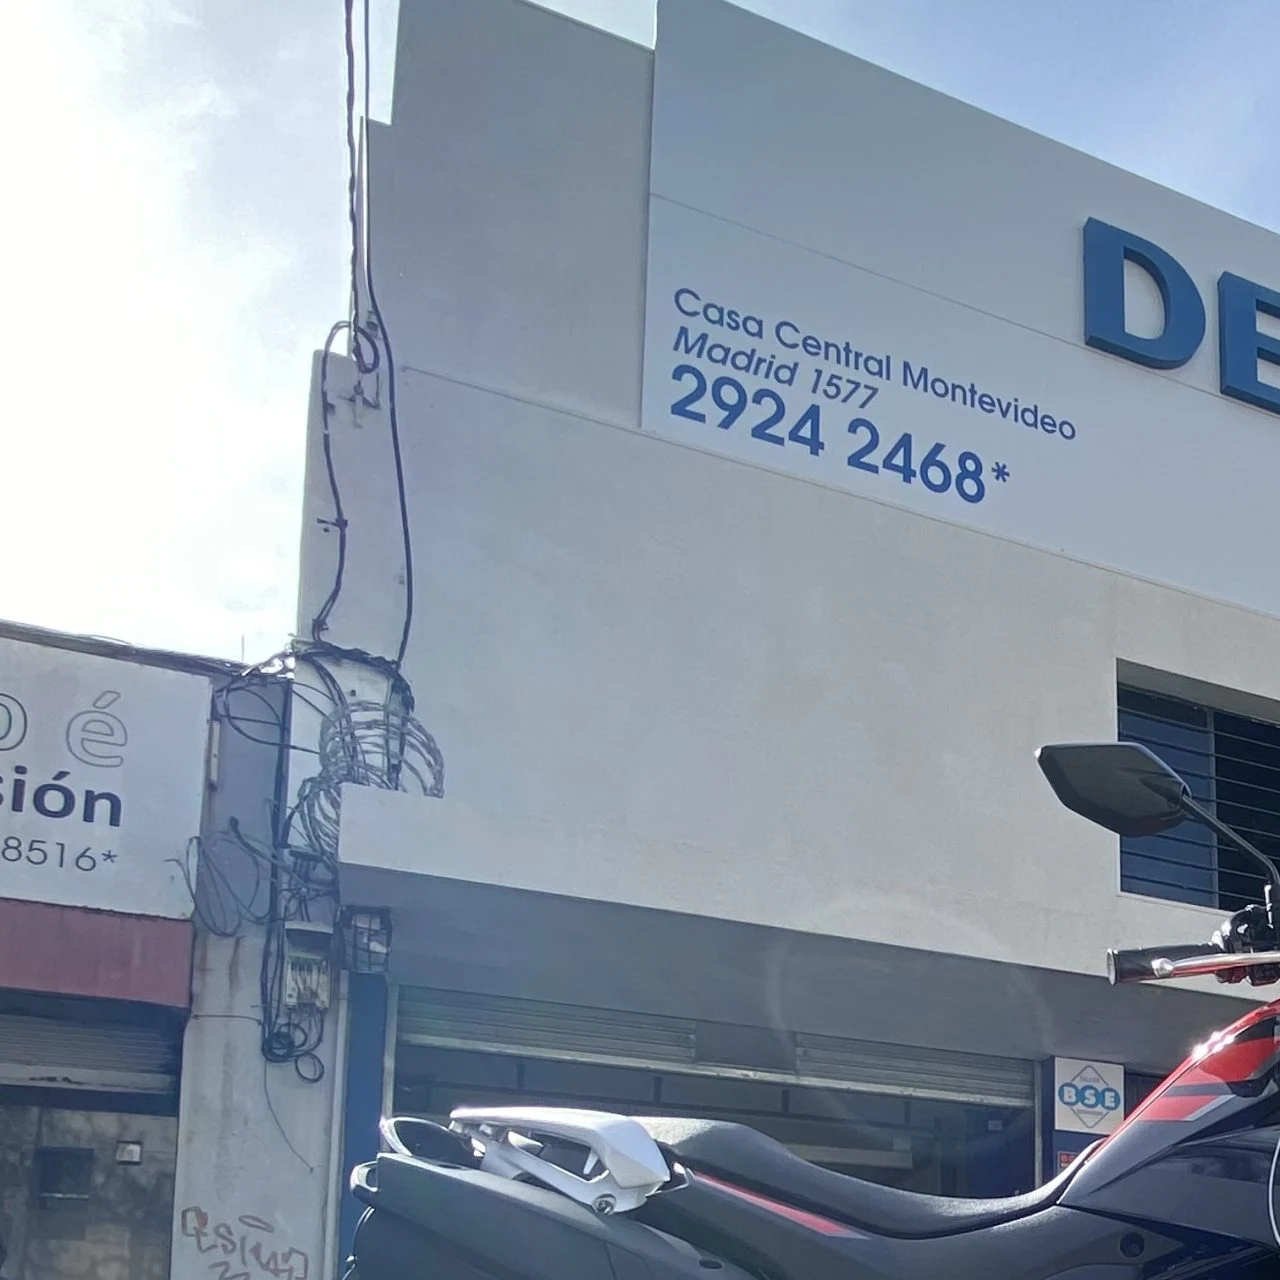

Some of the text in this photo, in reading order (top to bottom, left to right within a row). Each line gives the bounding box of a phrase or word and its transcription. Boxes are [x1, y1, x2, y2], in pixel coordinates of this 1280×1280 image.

[673, 327, 879, 409] Madrid 1577
[674, 288, 1077, 441] Casa Central Montevideo
[670, 364, 825, 456] 2924
[1062, 1086, 1116, 1108] BSE
